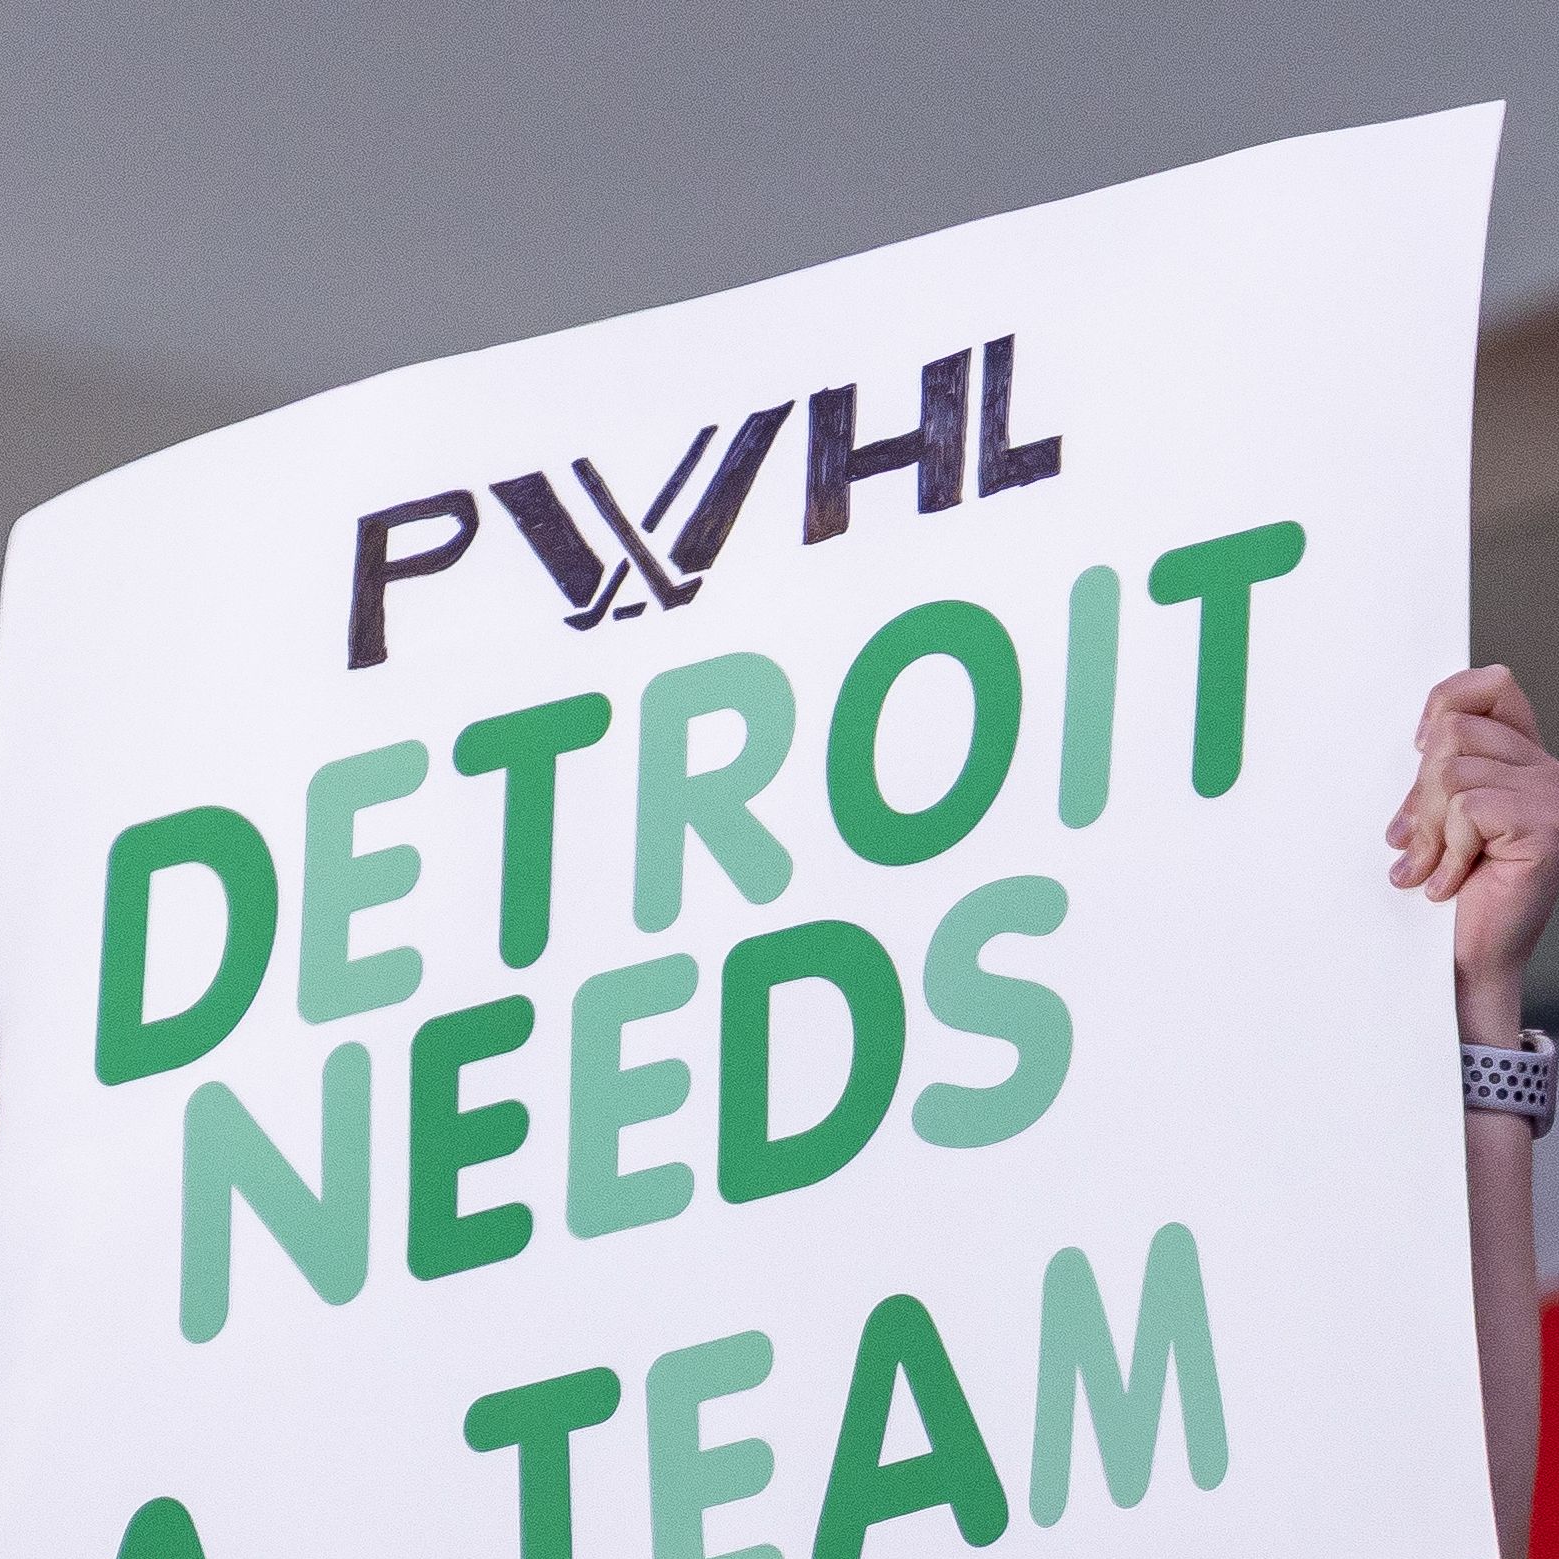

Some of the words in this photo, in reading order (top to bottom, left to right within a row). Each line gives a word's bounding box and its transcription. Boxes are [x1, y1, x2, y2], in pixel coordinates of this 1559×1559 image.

[347, 332, 1063, 670] PWHL
[94, 521, 1305, 1087] DETROIT
[181, 874, 1076, 1341] NEEDS
